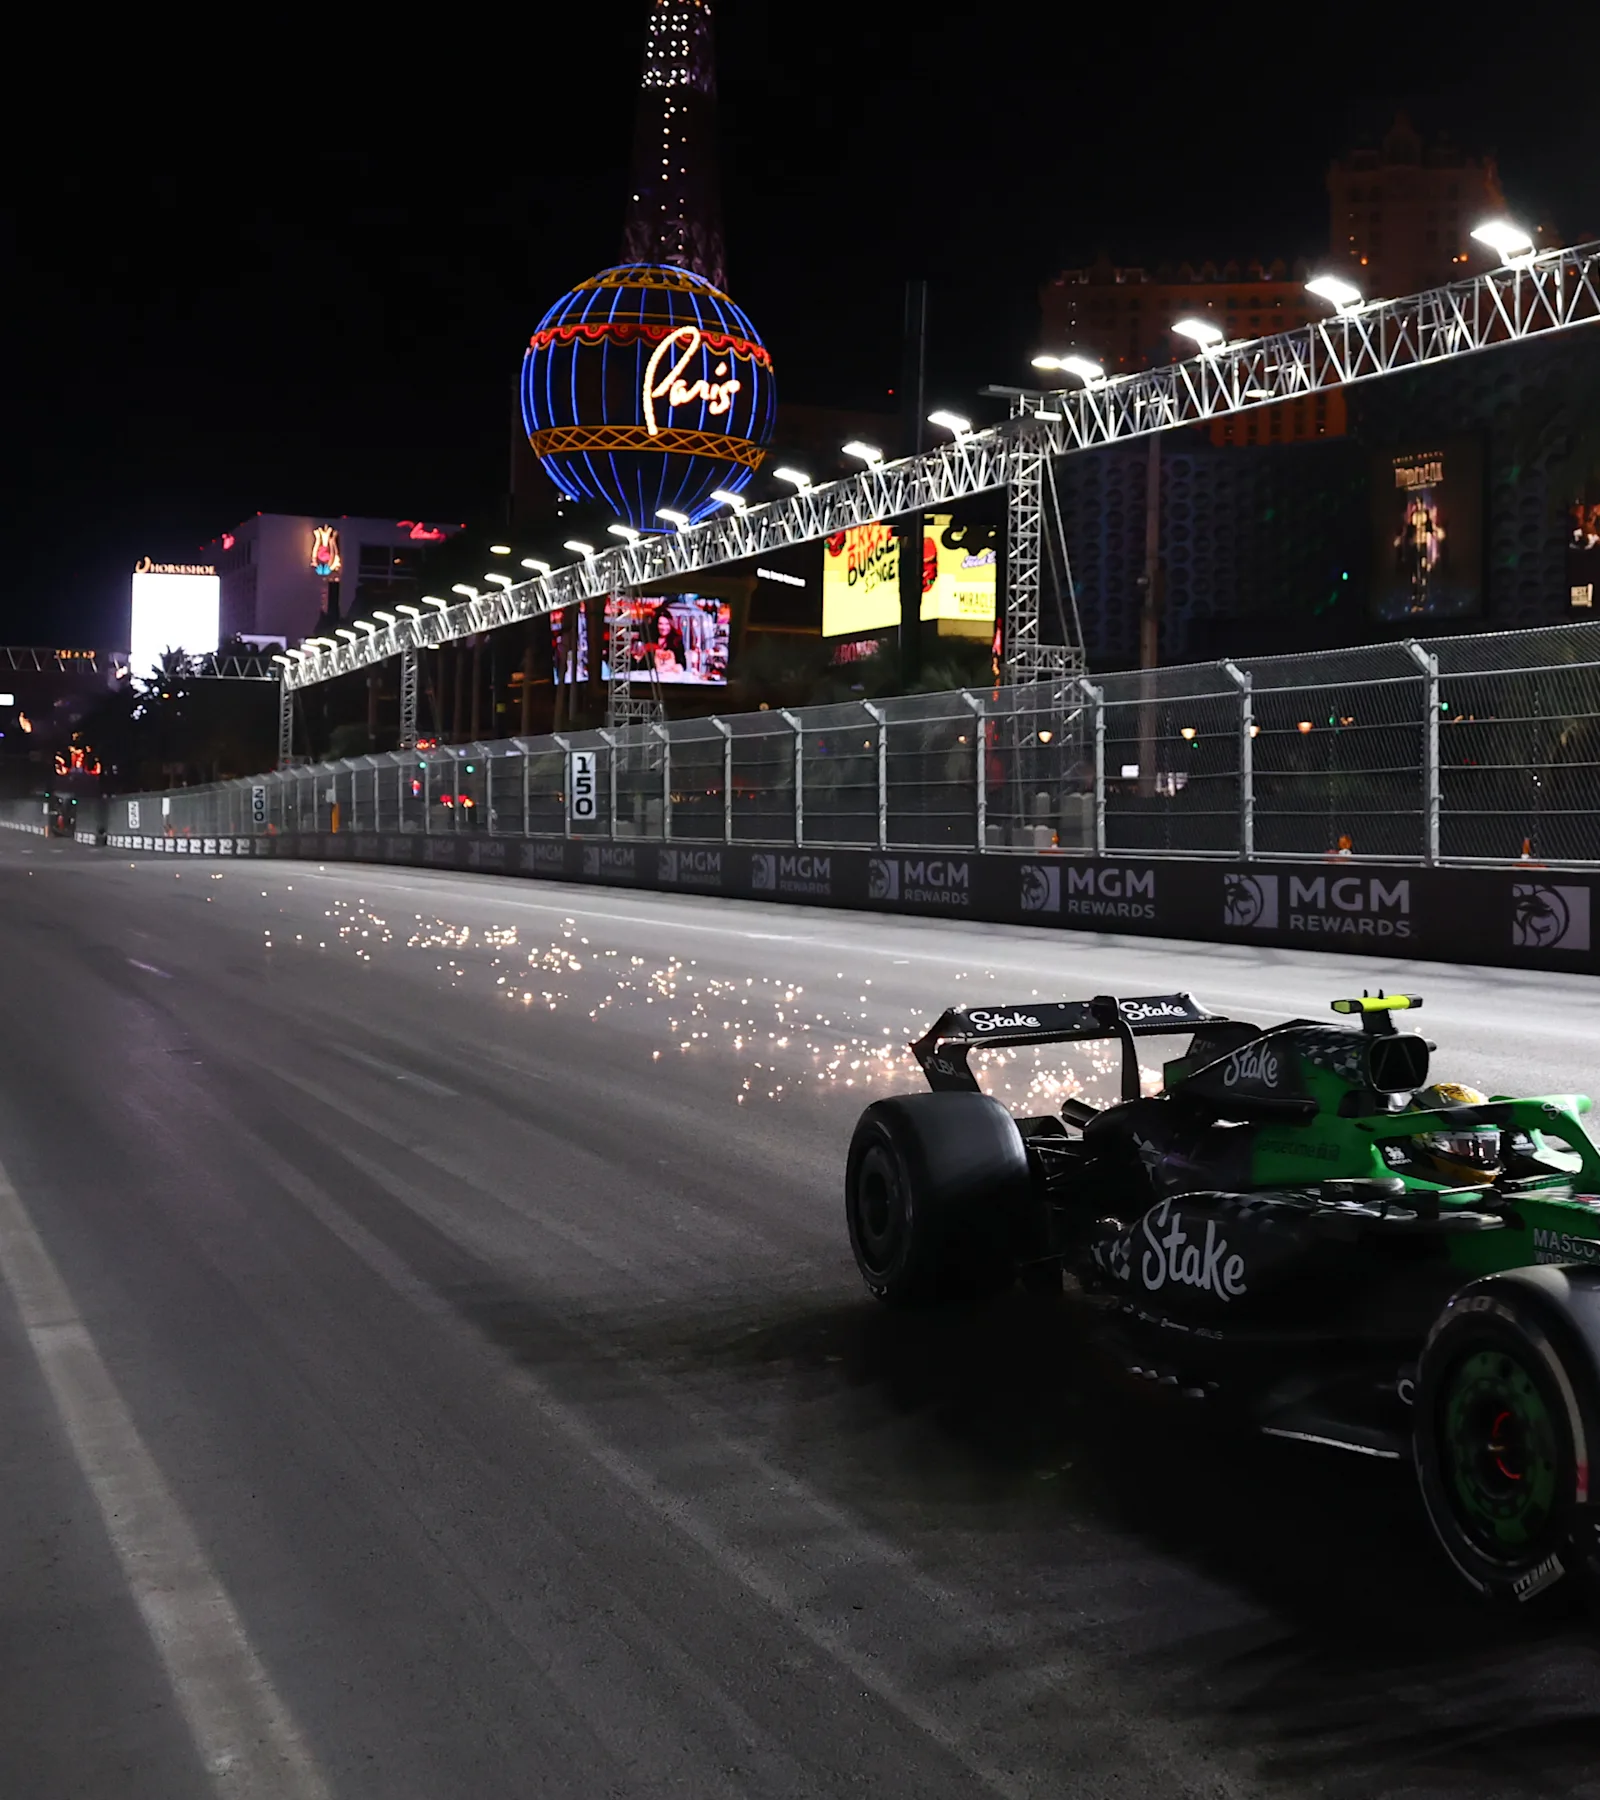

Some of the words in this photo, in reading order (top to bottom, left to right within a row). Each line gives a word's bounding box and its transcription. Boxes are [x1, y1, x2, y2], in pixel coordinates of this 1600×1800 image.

[643, 325, 741, 436] Paris
[150, 563, 216, 575] HORSESHOE
[575, 756, 593, 815] 150
[254, 788, 265, 822] 200
[601, 848, 634, 866] MGM
[680, 850, 721, 872] MGM
[780, 855, 831, 879] MGM
[904, 860, 968, 887] MGM
[1068, 867, 1155, 900] MGM
[780, 880, 831, 895] REWARDS
[905, 888, 969, 906] REWARDS
[1290, 875, 1409, 914] MGM
[1068, 899, 1155, 920] REWARDS
[1290, 914, 1410, 938] REWARDS
[968, 1010, 1042, 1032] Stake
[1120, 1001, 1189, 1021] Stake
[1223, 1041, 1279, 1088] Stake
[1141, 1196, 1248, 1303] Stake
